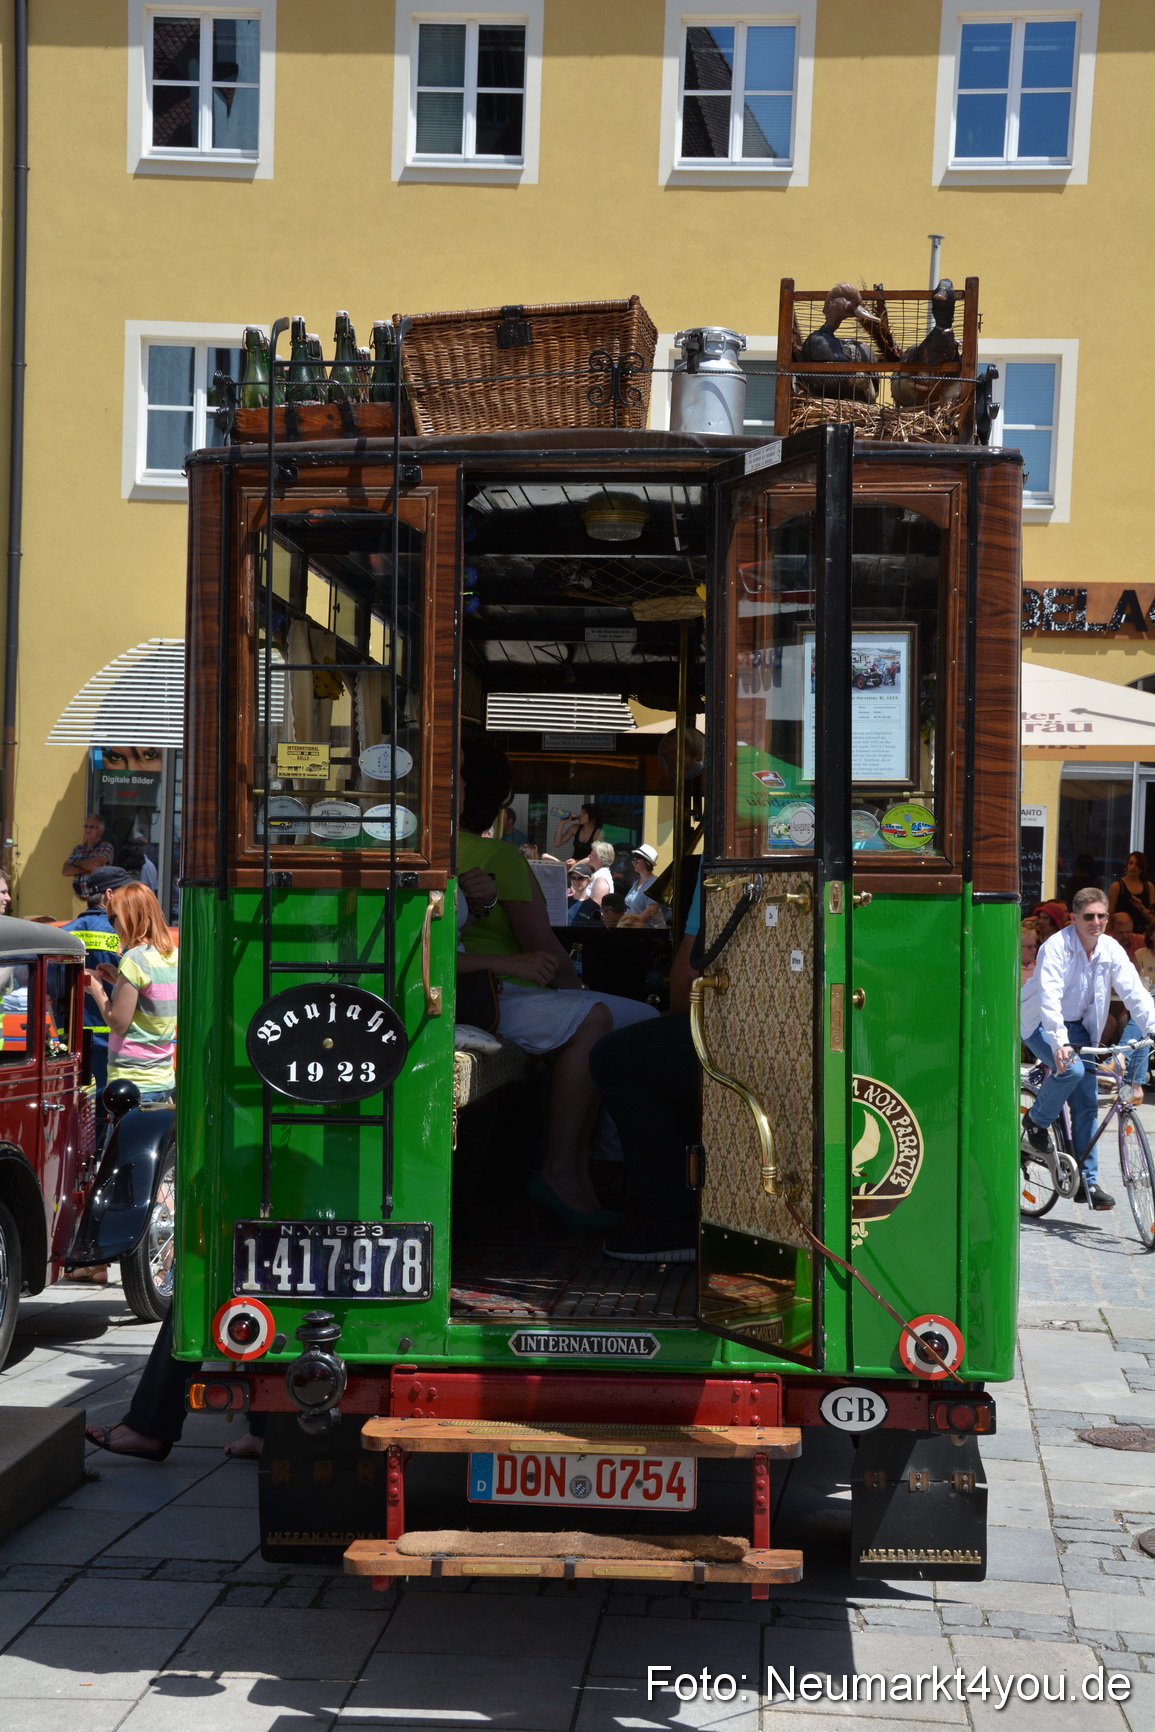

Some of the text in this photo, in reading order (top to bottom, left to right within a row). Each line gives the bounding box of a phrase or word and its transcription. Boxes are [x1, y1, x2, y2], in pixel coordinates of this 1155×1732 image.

[1022, 711, 1061, 720] ter
[1025, 720, 1093, 733] räu
[102, 775, 154, 785] Digitale Bilder
[793, 822, 810, 834] Ausgang
[256, 993, 397, 1045] Baujahr
[286, 1061, 376, 1083] 1923
[864, 1084, 902, 1117] NON
[890, 1114, 918, 1187] PARATUS
[520, 1336, 648, 1354] INTERNATIONAL
[831, 1396, 876, 1422] GB
[476, 1480, 486, 1492] D
[496, 1455, 686, 1502] DON 0754
[860, 1549, 981, 1564] INTERNATIONAL
